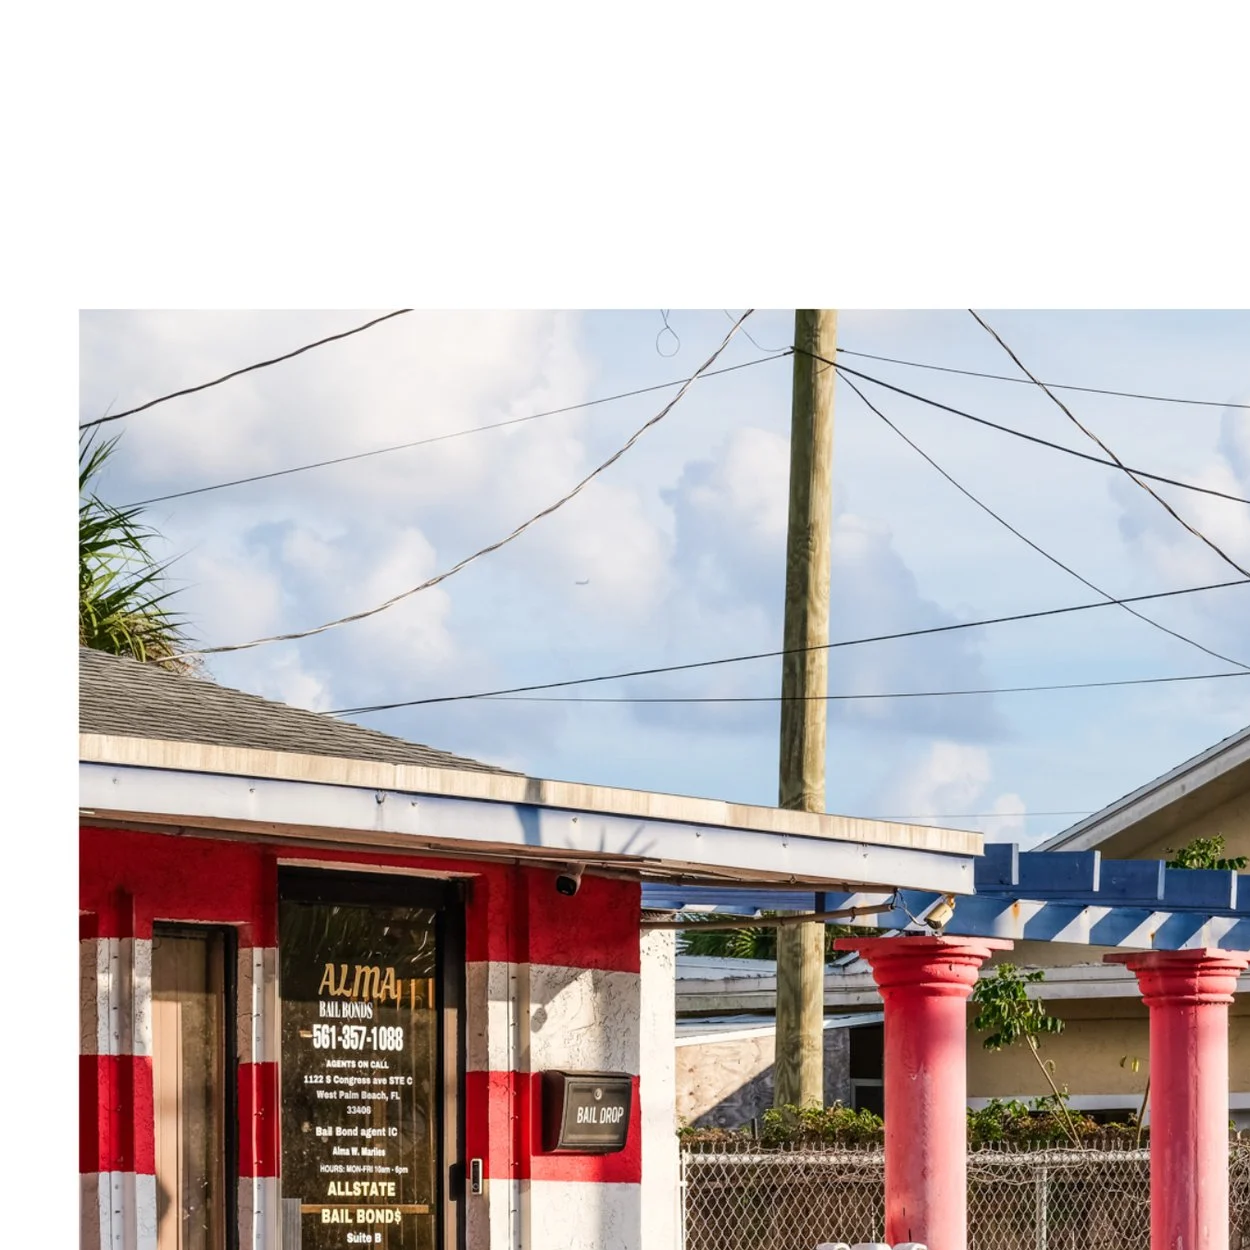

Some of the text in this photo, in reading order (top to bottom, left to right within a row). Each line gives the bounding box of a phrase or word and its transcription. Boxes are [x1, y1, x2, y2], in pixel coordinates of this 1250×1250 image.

[318, 963, 398, 998] ALMA
[319, 1001, 373, 1019] BAIL BONDS
[312, 1024, 404, 1051] 561-357-1088
[326, 1060, 389, 1069] AGENTS ON CALL
[303, 1075, 413, 1086] 1122 S Congress ave STE C
[316, 1090, 401, 1101] West Palm Beach, FL
[576, 1106, 624, 1124] BAIL DROP
[315, 1126, 333, 1136] Bail
[335, 1126, 358, 1136] Bond
[360, 1126, 386, 1138] agent
[332, 1146, 350, 1156] Alma
[320, 1164, 345, 1173] HOURS:
[346, 1165, 373, 1173] MON-FRI
[327, 1181, 396, 1197] ALLSTATE
[321, 1207, 402, 1224] BAIL BOND$
[346, 1232, 382, 1243] Suite B
